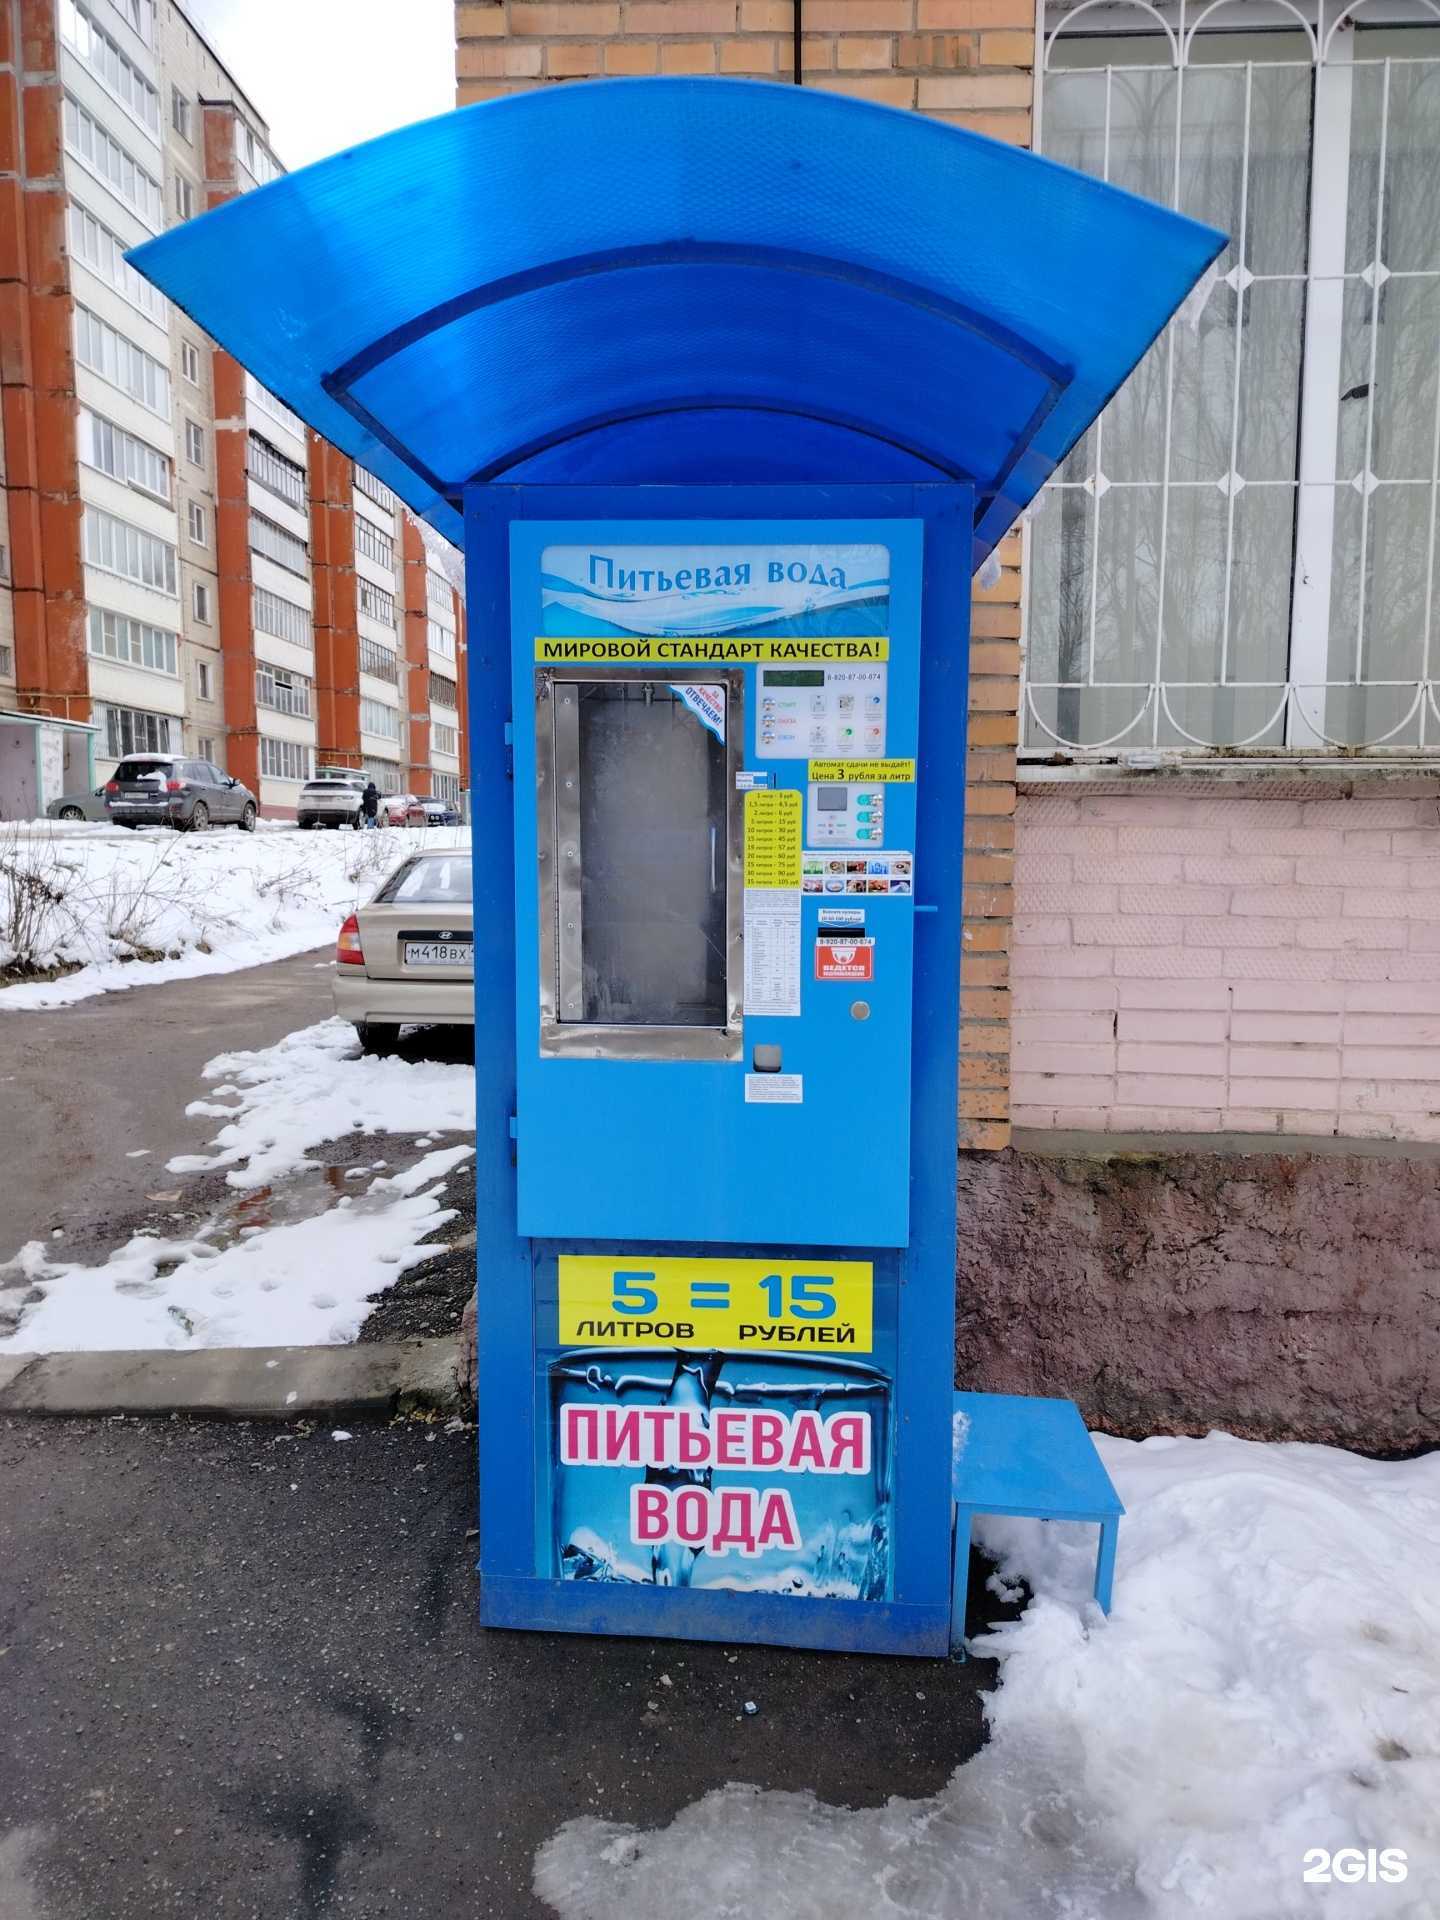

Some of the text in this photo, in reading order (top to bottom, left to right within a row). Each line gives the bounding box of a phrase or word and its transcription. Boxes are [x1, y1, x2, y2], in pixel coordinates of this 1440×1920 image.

[589, 554, 847, 592] Питьевая вода
[543, 639, 880, 660] МИРОВОЙ СТАНДАРТ КАЧЕСТВА!
[685, 687, 722, 727] ОТВЕЧАЕМ!
[812, 772, 834, 782] Цена
[837, 769, 844, 780] 3
[848, 772, 875, 781] рубля
[889, 773, 911, 781] литр
[846, 761, 868, 769] сдачи
[410, 946, 466, 960] М418ВХ
[611, 1271, 658, 1315] 5
[758, 1273, 837, 1319] 15
[575, 1320, 856, 1344] ЛИТРОВ РУБЛЕЙ
[567, 1408, 864, 1468] ПИТЬЕВАЯ
[636, 1489, 796, 1553] ВОДА
